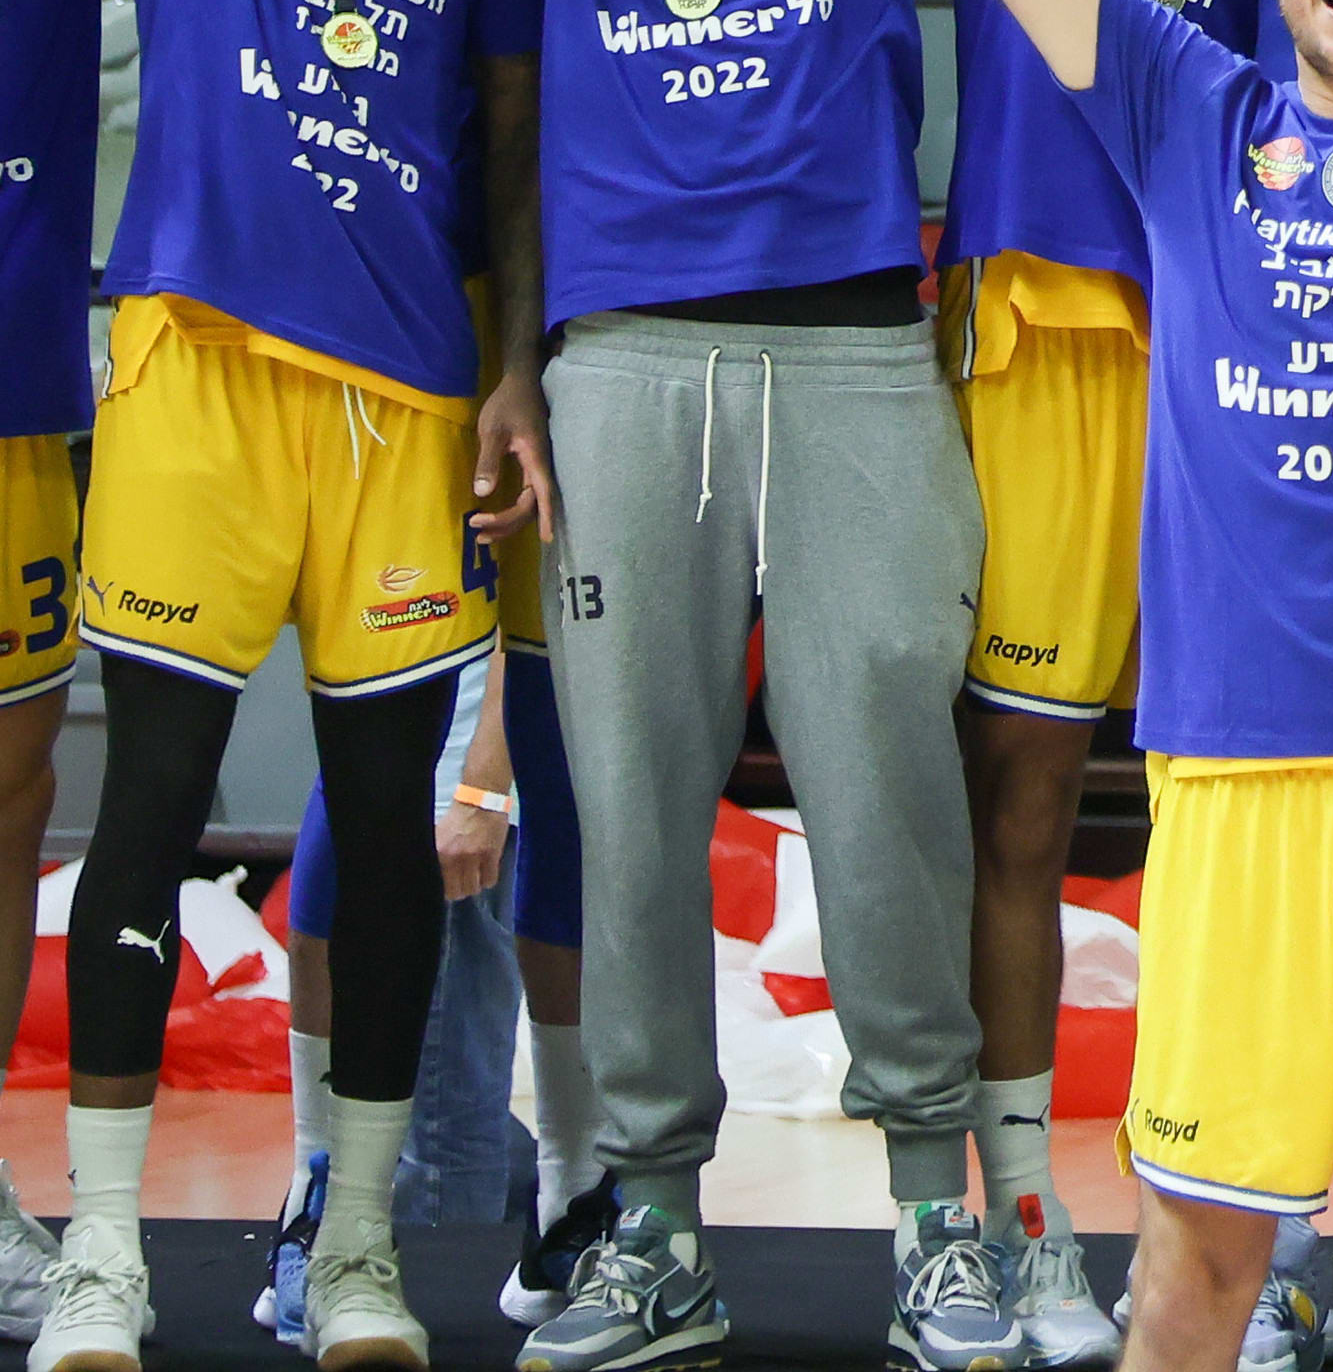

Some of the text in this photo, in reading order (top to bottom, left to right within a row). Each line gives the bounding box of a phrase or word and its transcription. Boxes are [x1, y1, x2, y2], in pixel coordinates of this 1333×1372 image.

[597, 2, 787, 56] Winner
[662, 56, 771, 104] 2022
[117, 589, 200, 624] Rapyd
[567, 574, 604, 621] 13
[984, 635, 1061, 667] Rapyd
[1144, 1109, 1200, 1144] Rapyd
